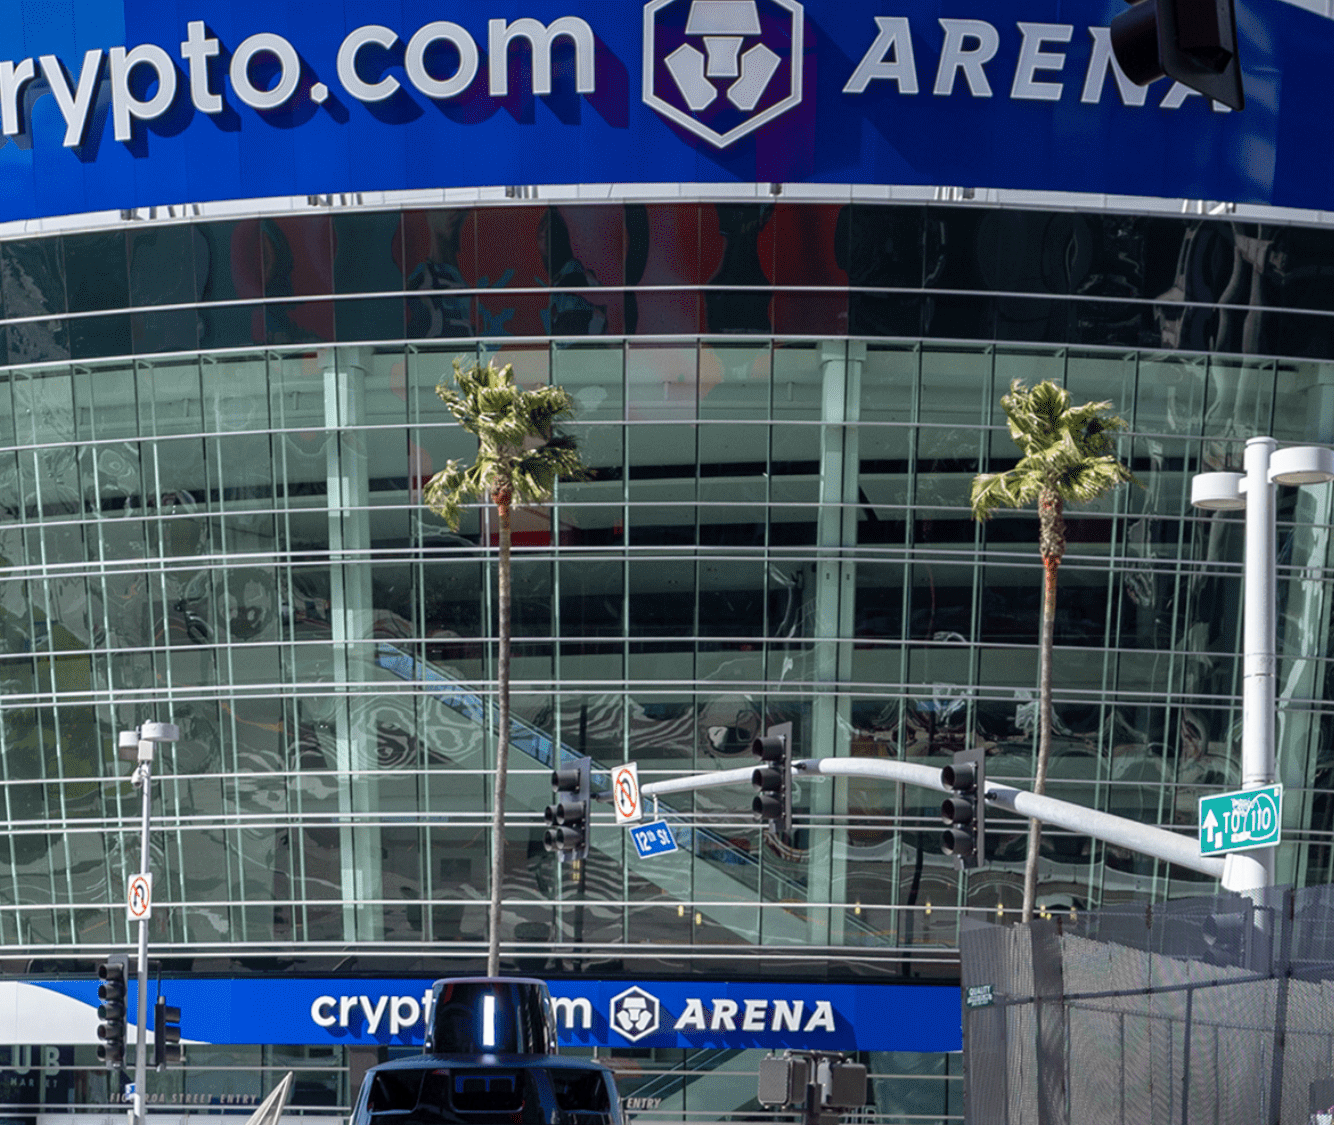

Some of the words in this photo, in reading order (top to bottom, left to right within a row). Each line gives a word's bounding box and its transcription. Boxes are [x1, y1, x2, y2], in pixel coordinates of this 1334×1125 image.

[1222, 808, 1241, 834] TO
[1251, 806, 1271, 832] 110
[310, 988, 592, 1035] cryptm
[673, 998, 836, 1032] ARENA
[172, 1094, 213, 1104] STREET
[220, 1094, 256, 1104] ENTRY
[627, 1098, 662, 1108] ENTRY
